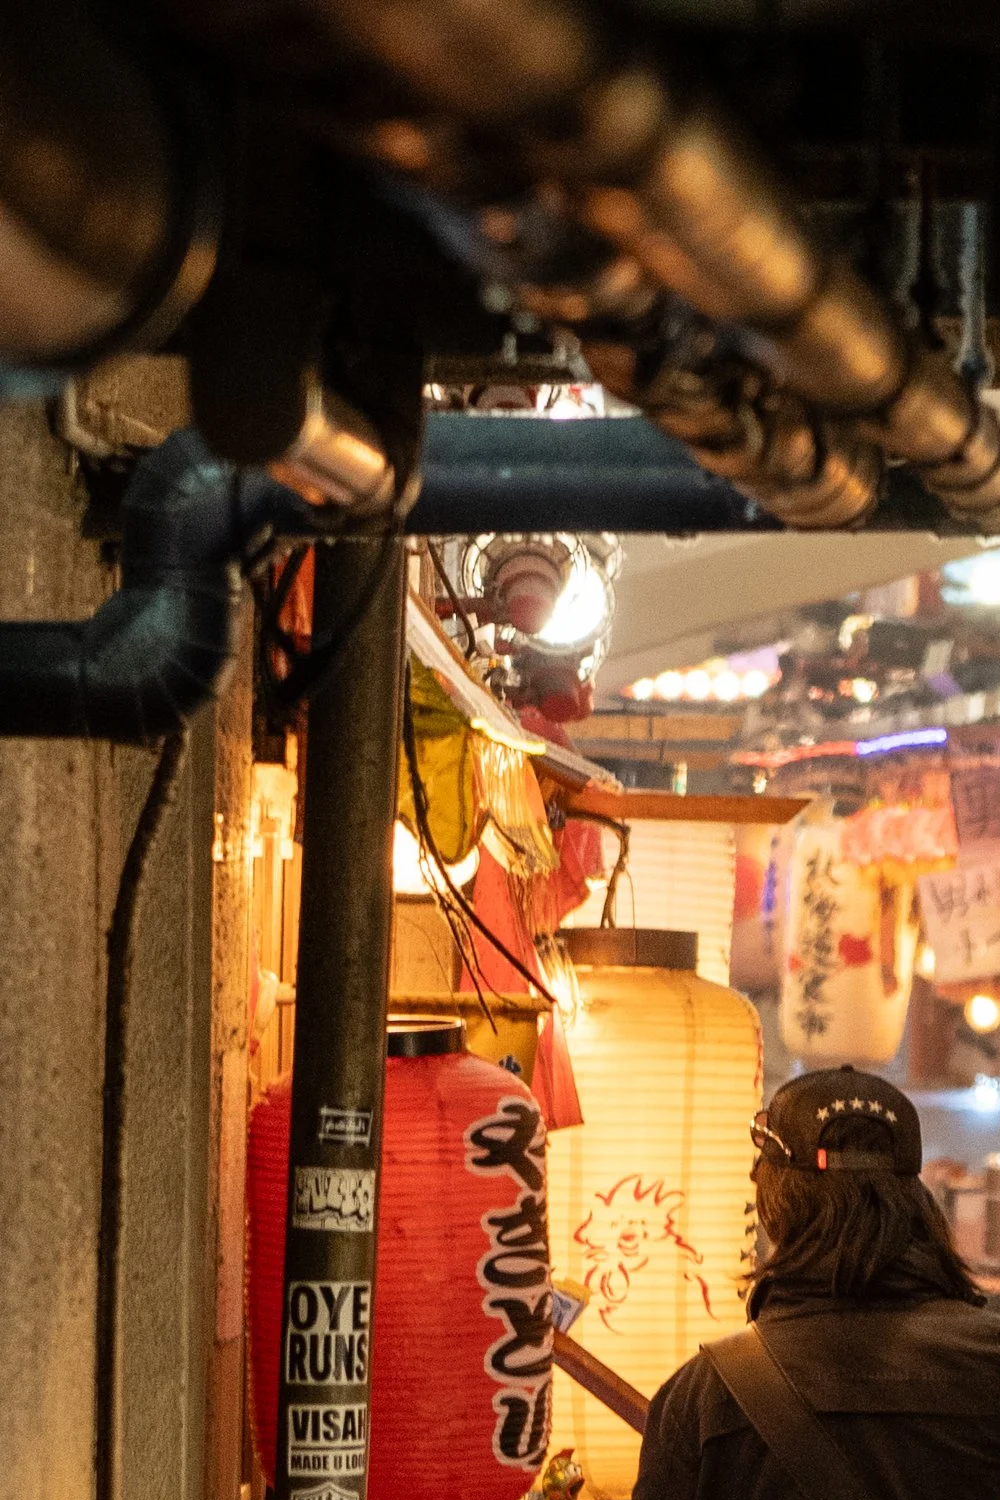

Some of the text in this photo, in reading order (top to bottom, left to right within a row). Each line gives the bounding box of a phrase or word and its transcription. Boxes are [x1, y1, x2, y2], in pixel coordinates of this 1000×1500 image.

[290, 1285, 369, 1331] OYE
[288, 1333, 367, 1382] RUNS
[290, 1453, 365, 1471] MADE U LOO
